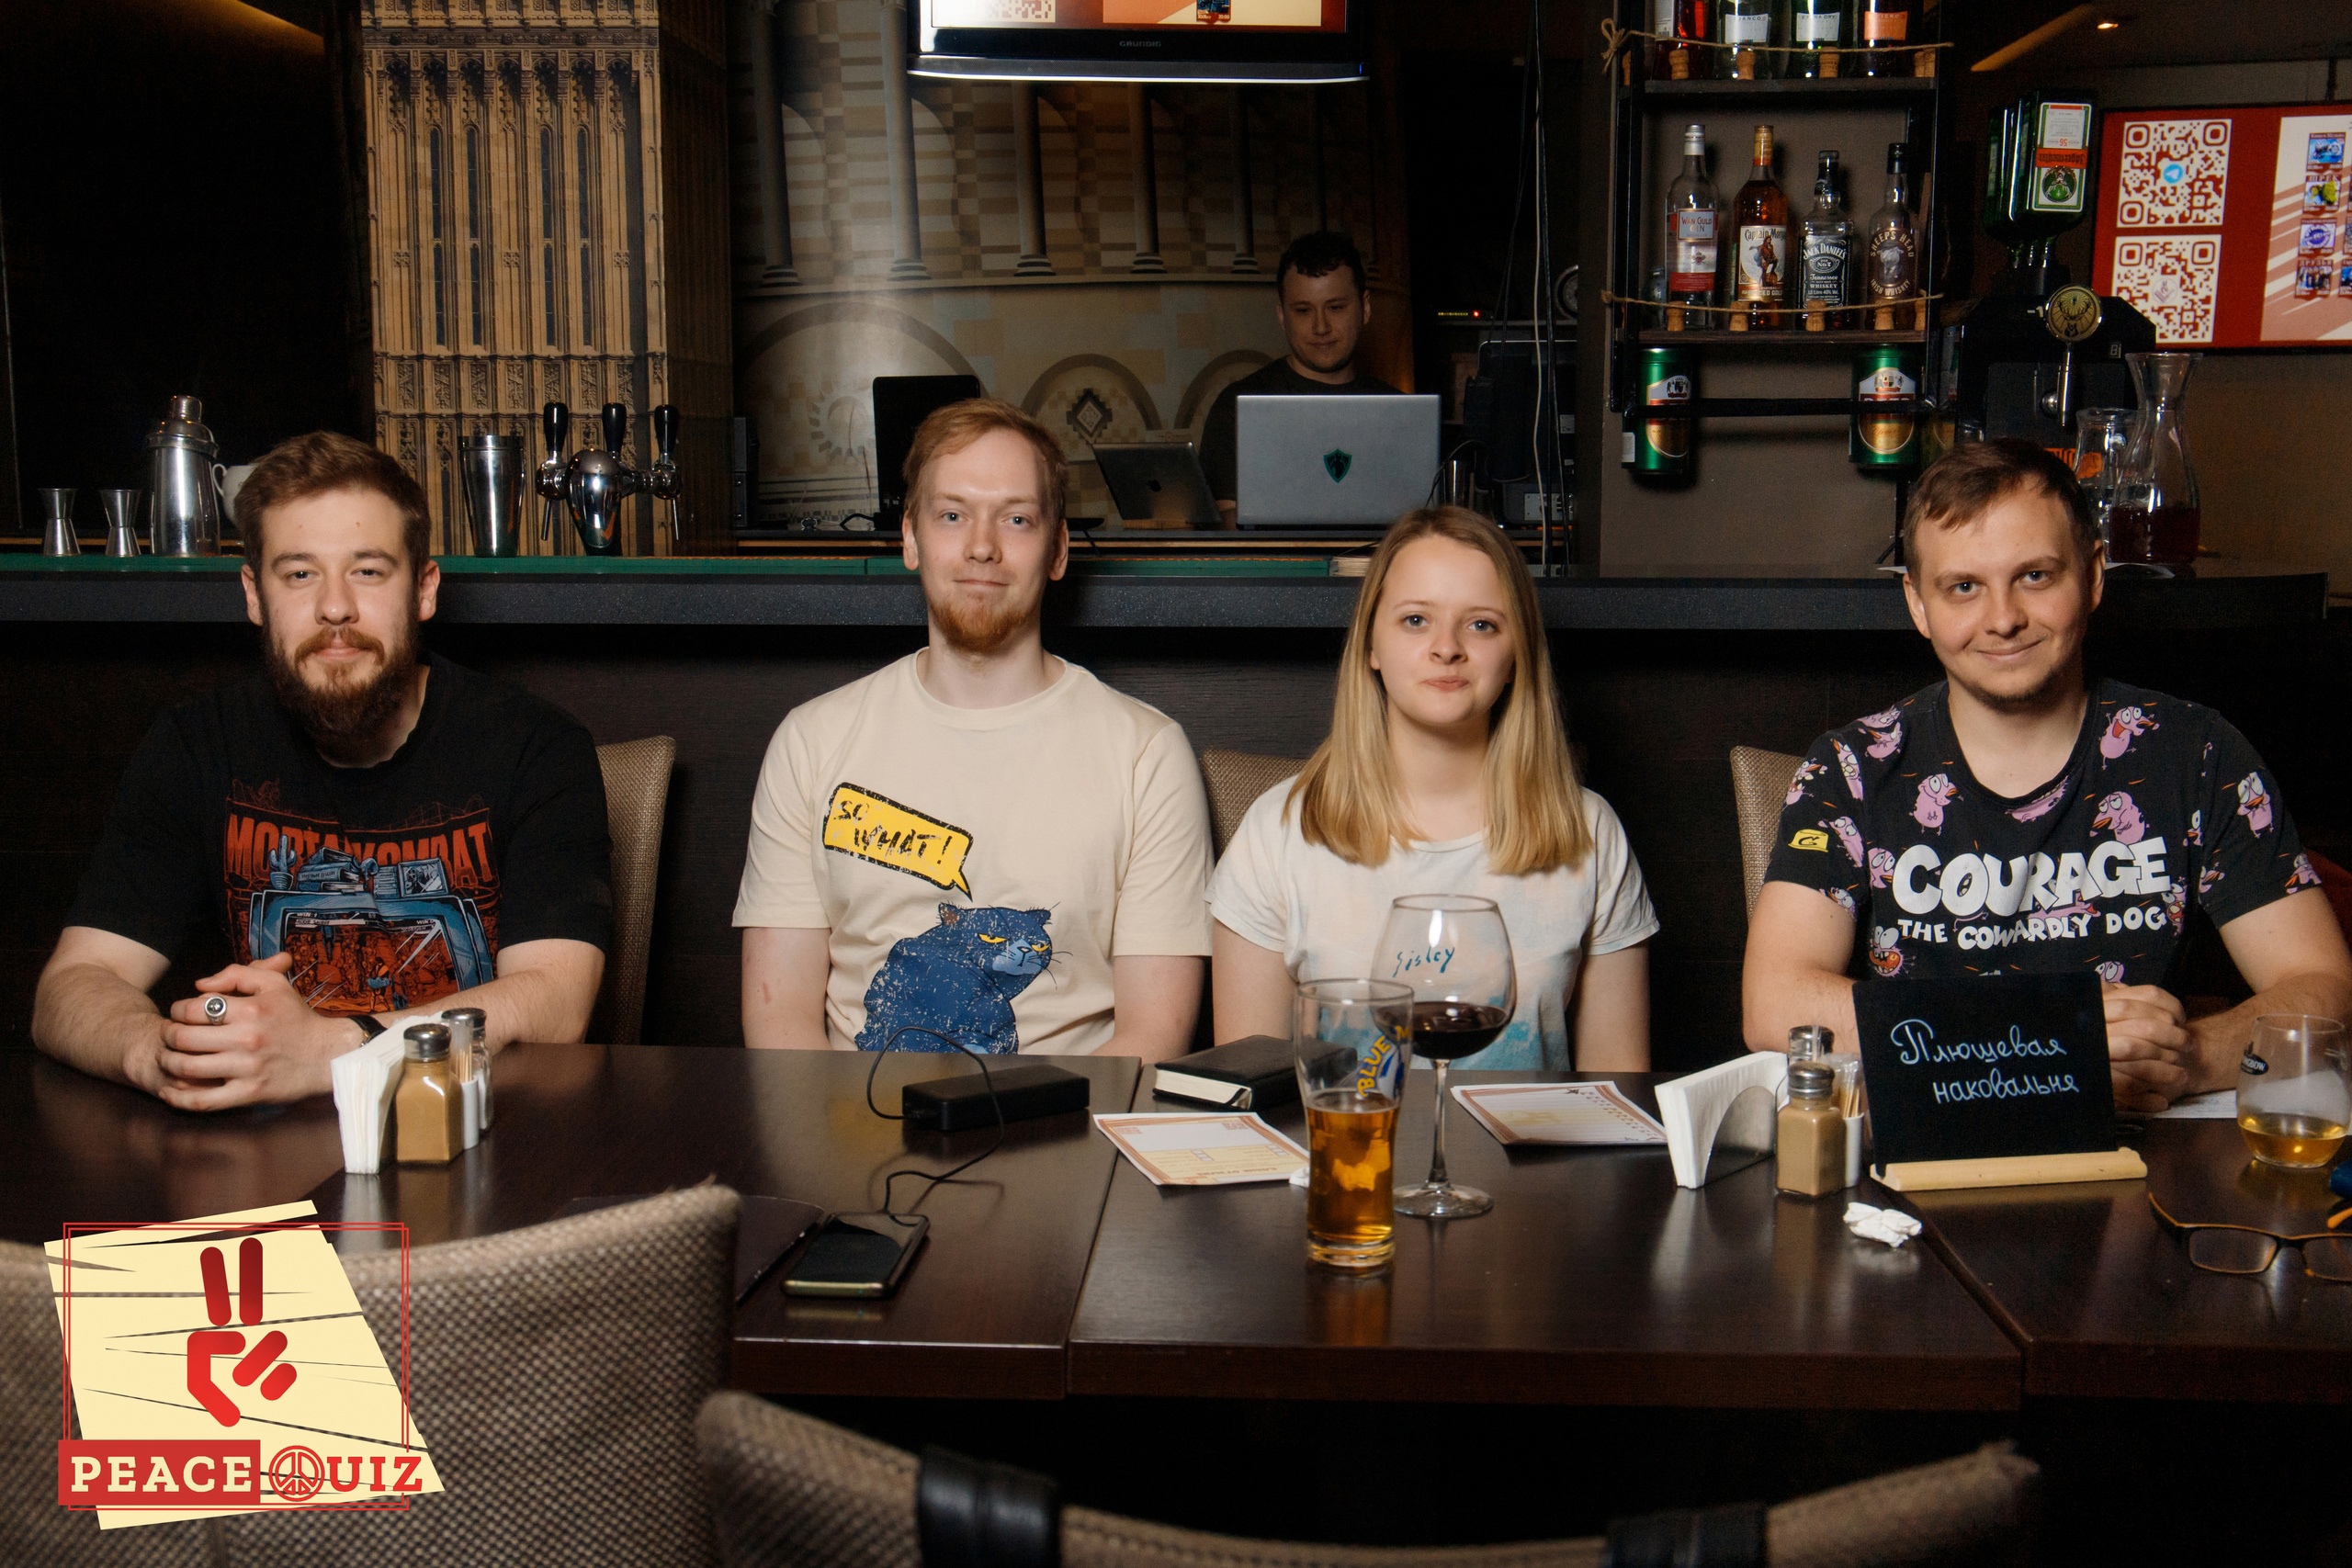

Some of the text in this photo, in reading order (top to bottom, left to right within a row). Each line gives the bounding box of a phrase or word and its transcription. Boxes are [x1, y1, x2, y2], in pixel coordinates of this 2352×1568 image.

[1804, 245, 1820, 261] JACK
[1899, 233, 1915, 257] HEAD
[1810, 273, 1838, 281] Tennessee
[1871, 278, 1911, 296] IRISH WHISKEY
[833, 800, 870, 821] SO
[854, 823, 953, 865] WHAT!
[1892, 836, 2171, 917] COURAGE
[1897, 906, 2167, 951] THE COWARDLY DOG
[1357, 1035, 1392, 1098] BLUE
[1932, 1067, 2080, 1104] наковальня
